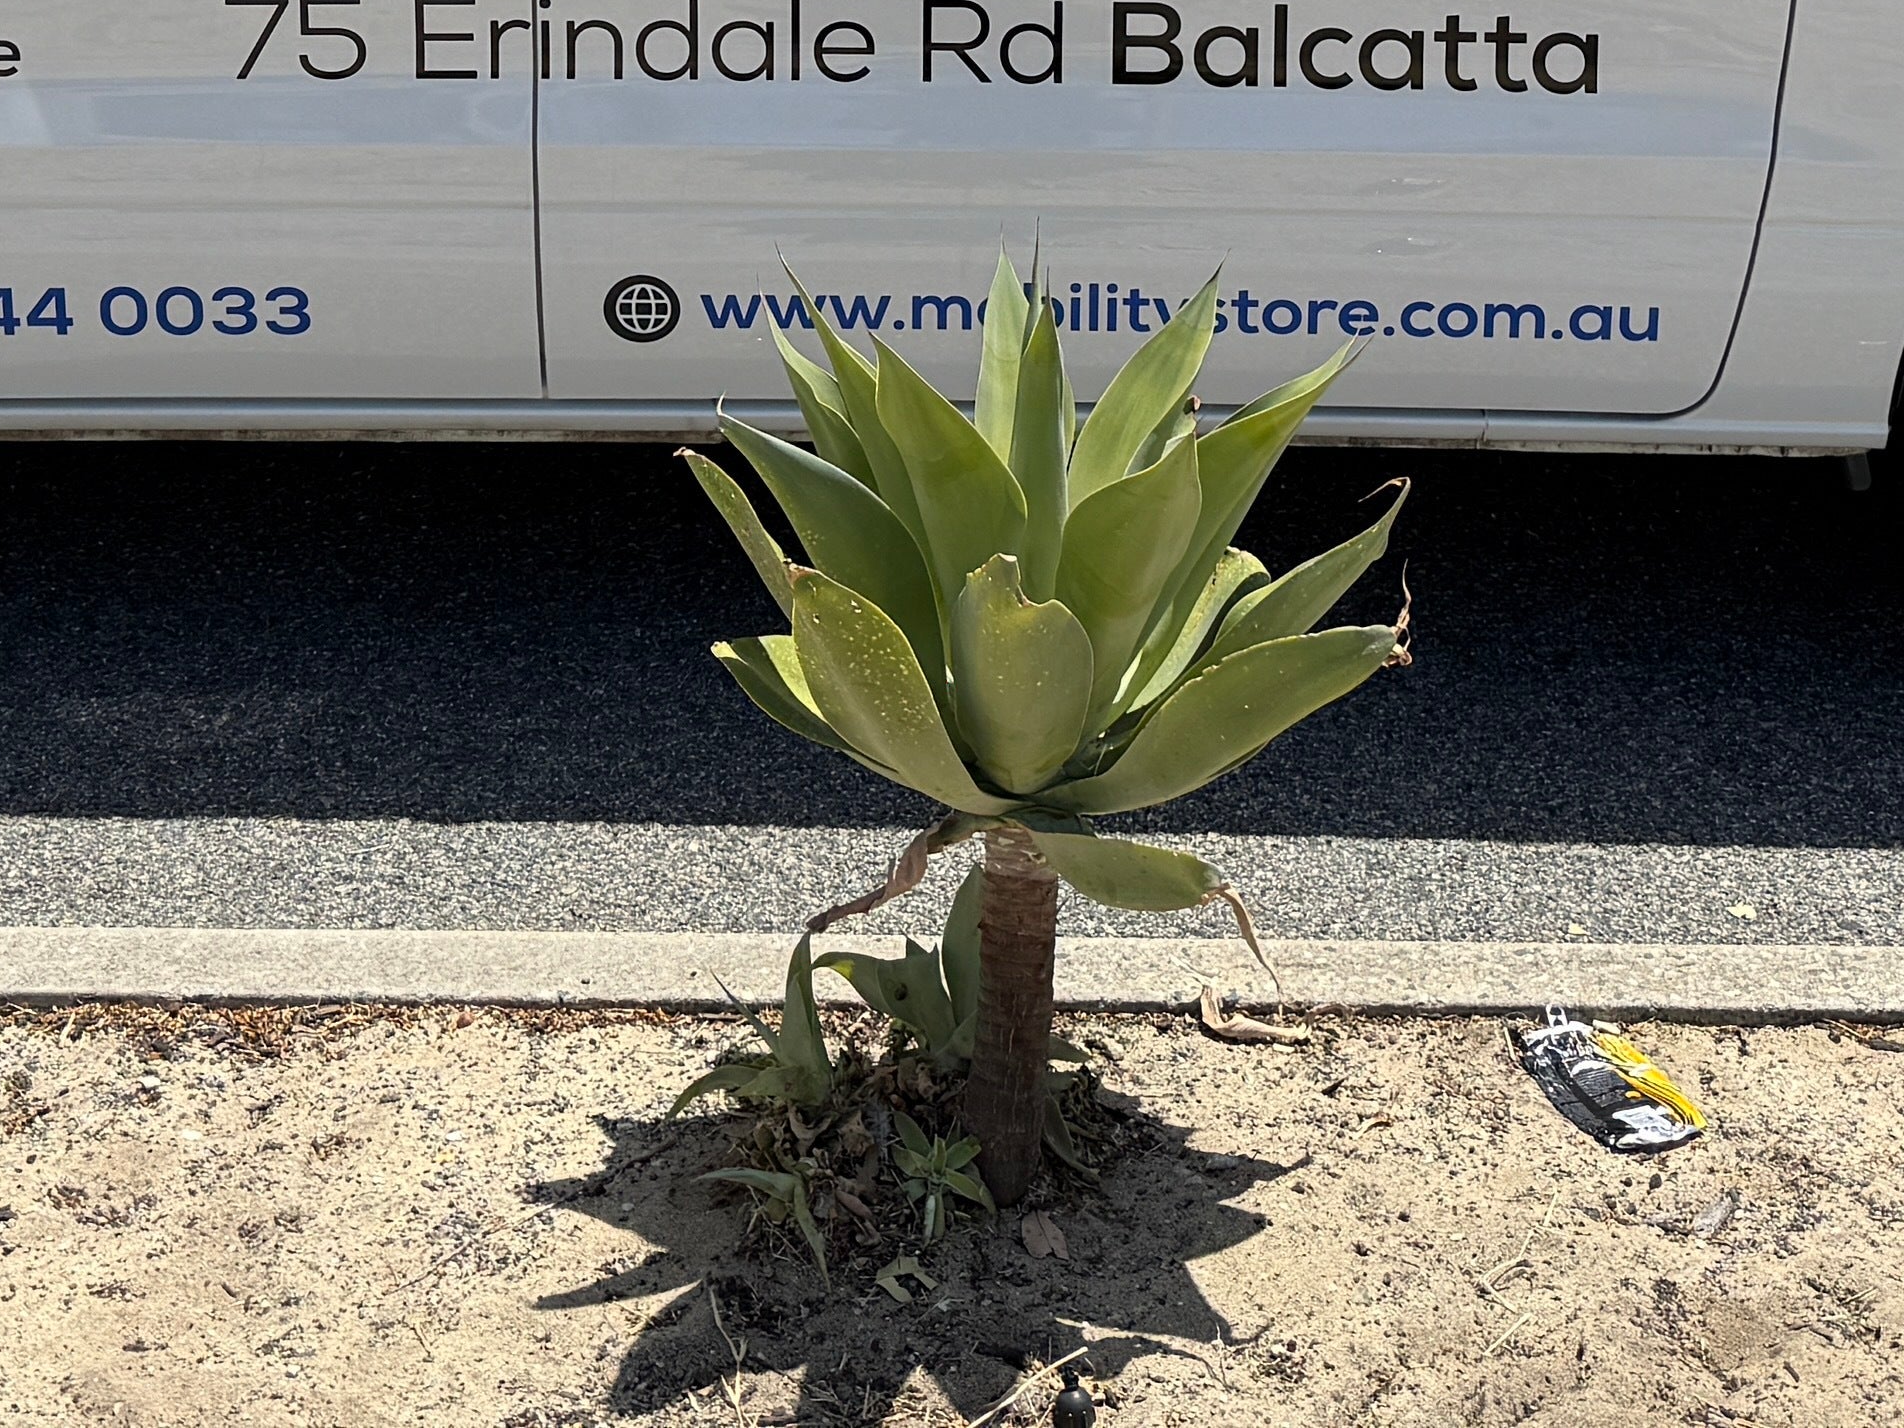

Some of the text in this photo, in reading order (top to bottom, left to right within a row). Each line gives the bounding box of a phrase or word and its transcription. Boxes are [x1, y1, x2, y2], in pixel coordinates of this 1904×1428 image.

[923, 0, 1063, 84] Rd
[1112, 2, 1598, 94] Balcatta
[100, 287, 310, 335] 0033
[700, 282, 1660, 342] www.milittore.com.au
